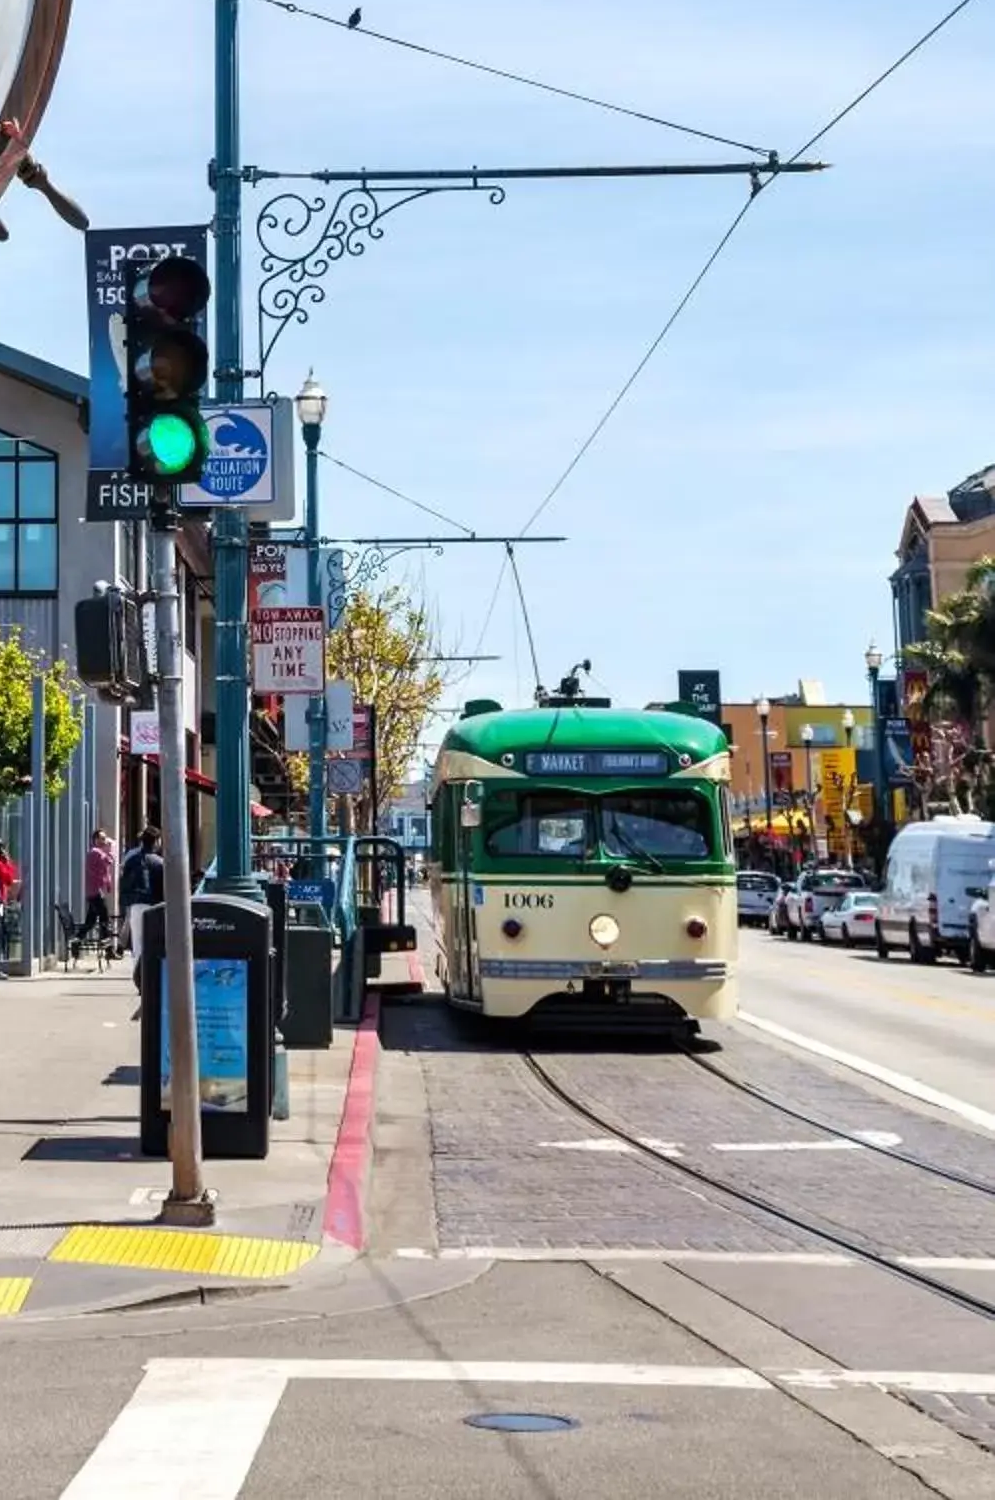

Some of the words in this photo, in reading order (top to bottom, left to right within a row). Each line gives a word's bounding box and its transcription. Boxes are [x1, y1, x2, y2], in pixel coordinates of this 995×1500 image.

[210, 475, 246, 492] ROUTE
[255, 609, 320, 621] TOW-AWAY
[251, 622, 273, 642] NO
[274, 626, 323, 641] STOPPING
[273, 645, 304, 661] ANY
[271, 663, 307, 677] TIME
[541, 753, 584, 770] MARKET
[504, 893, 555, 909] 1006
